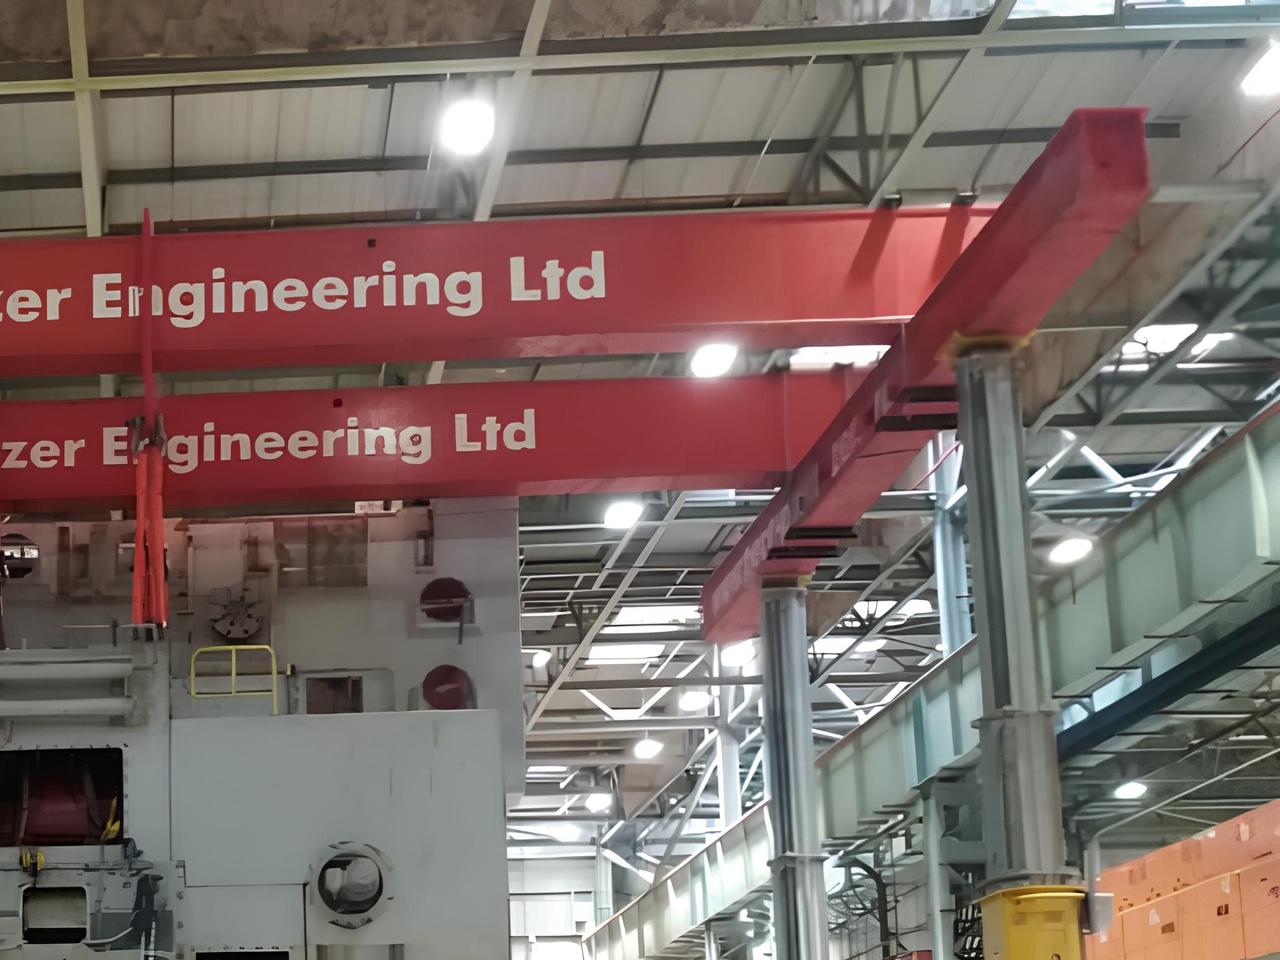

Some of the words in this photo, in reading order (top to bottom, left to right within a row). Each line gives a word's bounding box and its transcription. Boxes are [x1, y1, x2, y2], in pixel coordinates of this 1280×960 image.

[92, 260, 483, 328] Engineering
[509, 250, 606, 302] Ltd
[103, 417, 432, 474] Egineering
[454, 408, 536, 452] Ltd
